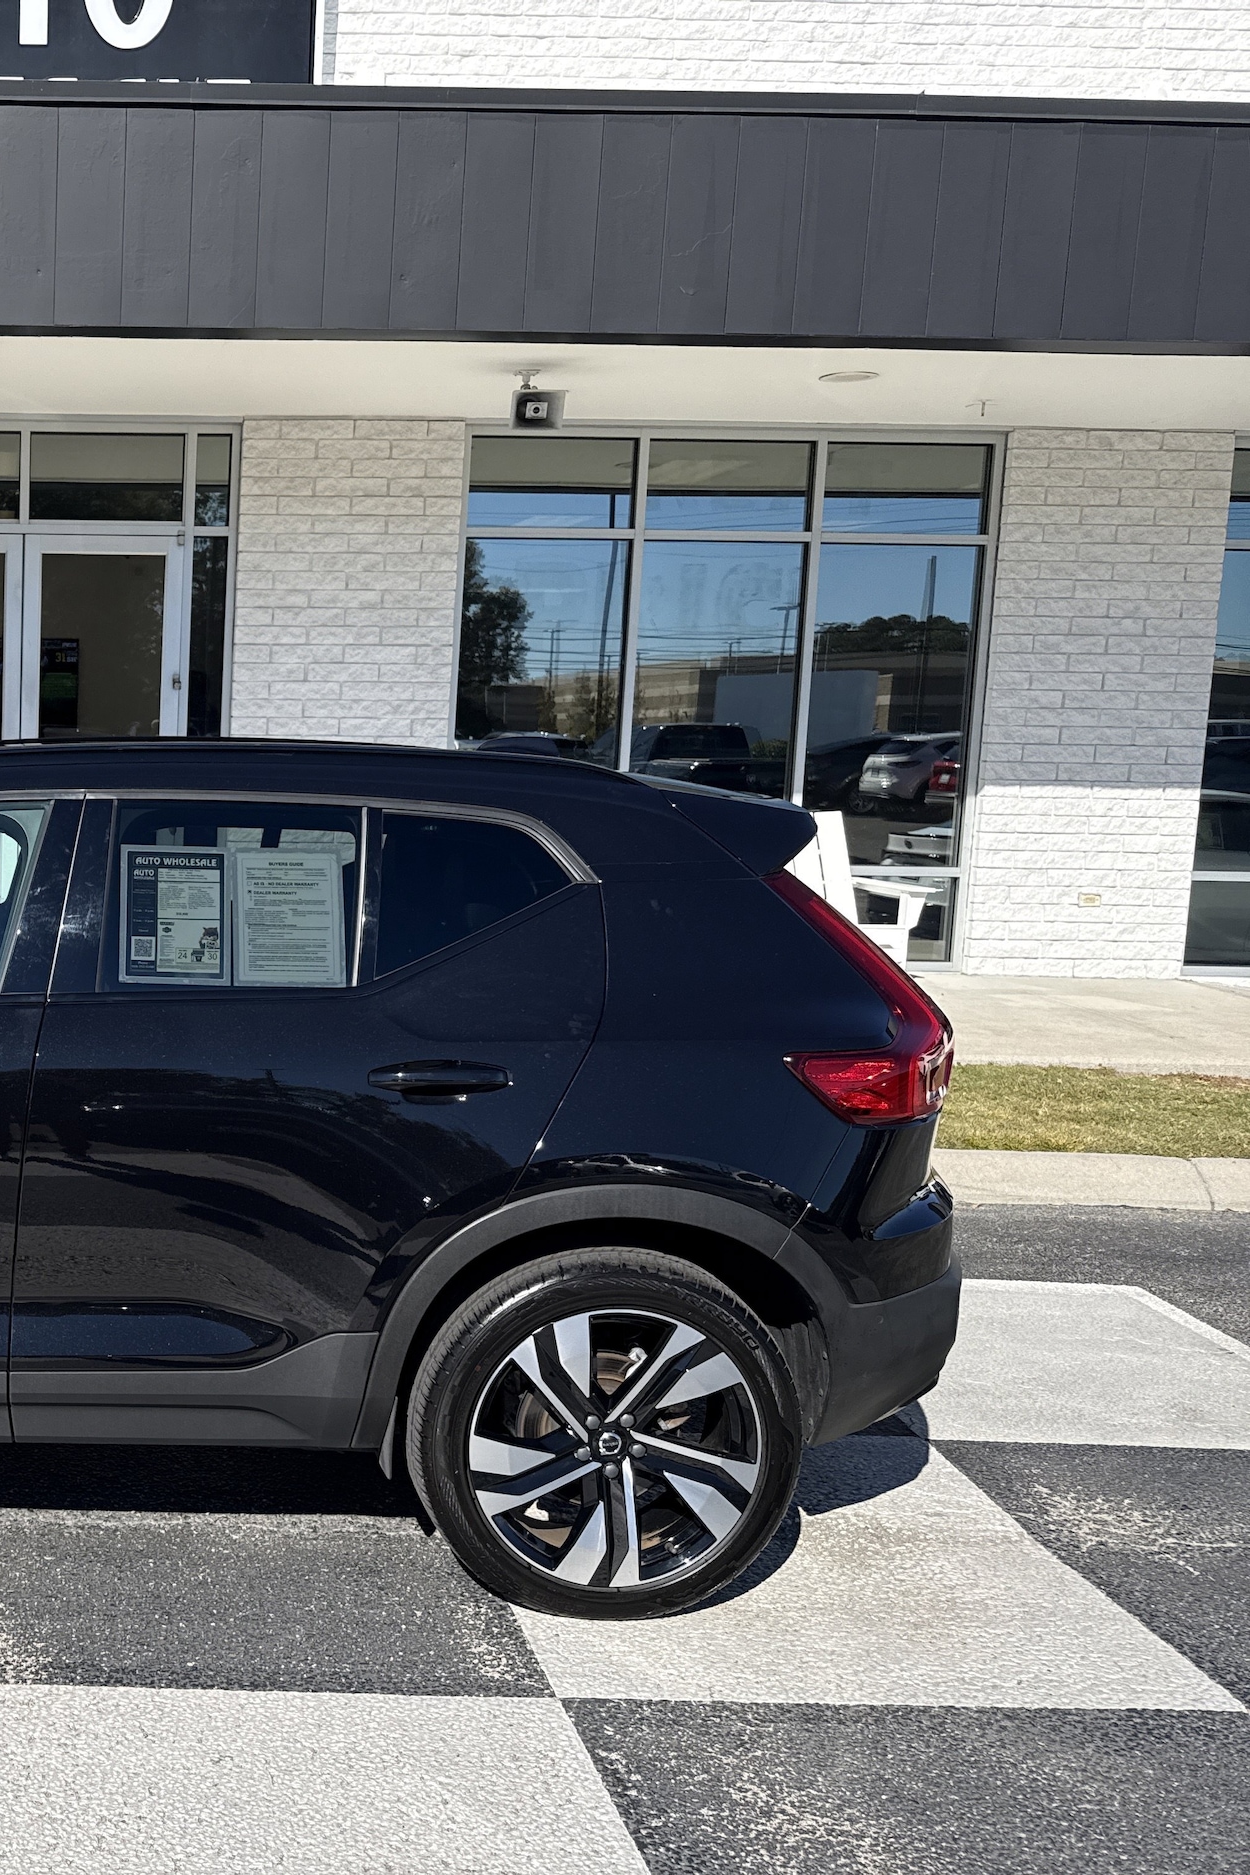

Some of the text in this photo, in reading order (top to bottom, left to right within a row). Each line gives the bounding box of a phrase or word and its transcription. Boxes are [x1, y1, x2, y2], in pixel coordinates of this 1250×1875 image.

[135, 856, 217, 867] AUTO WHOLESALE
[177, 952, 218, 961] 24 30
